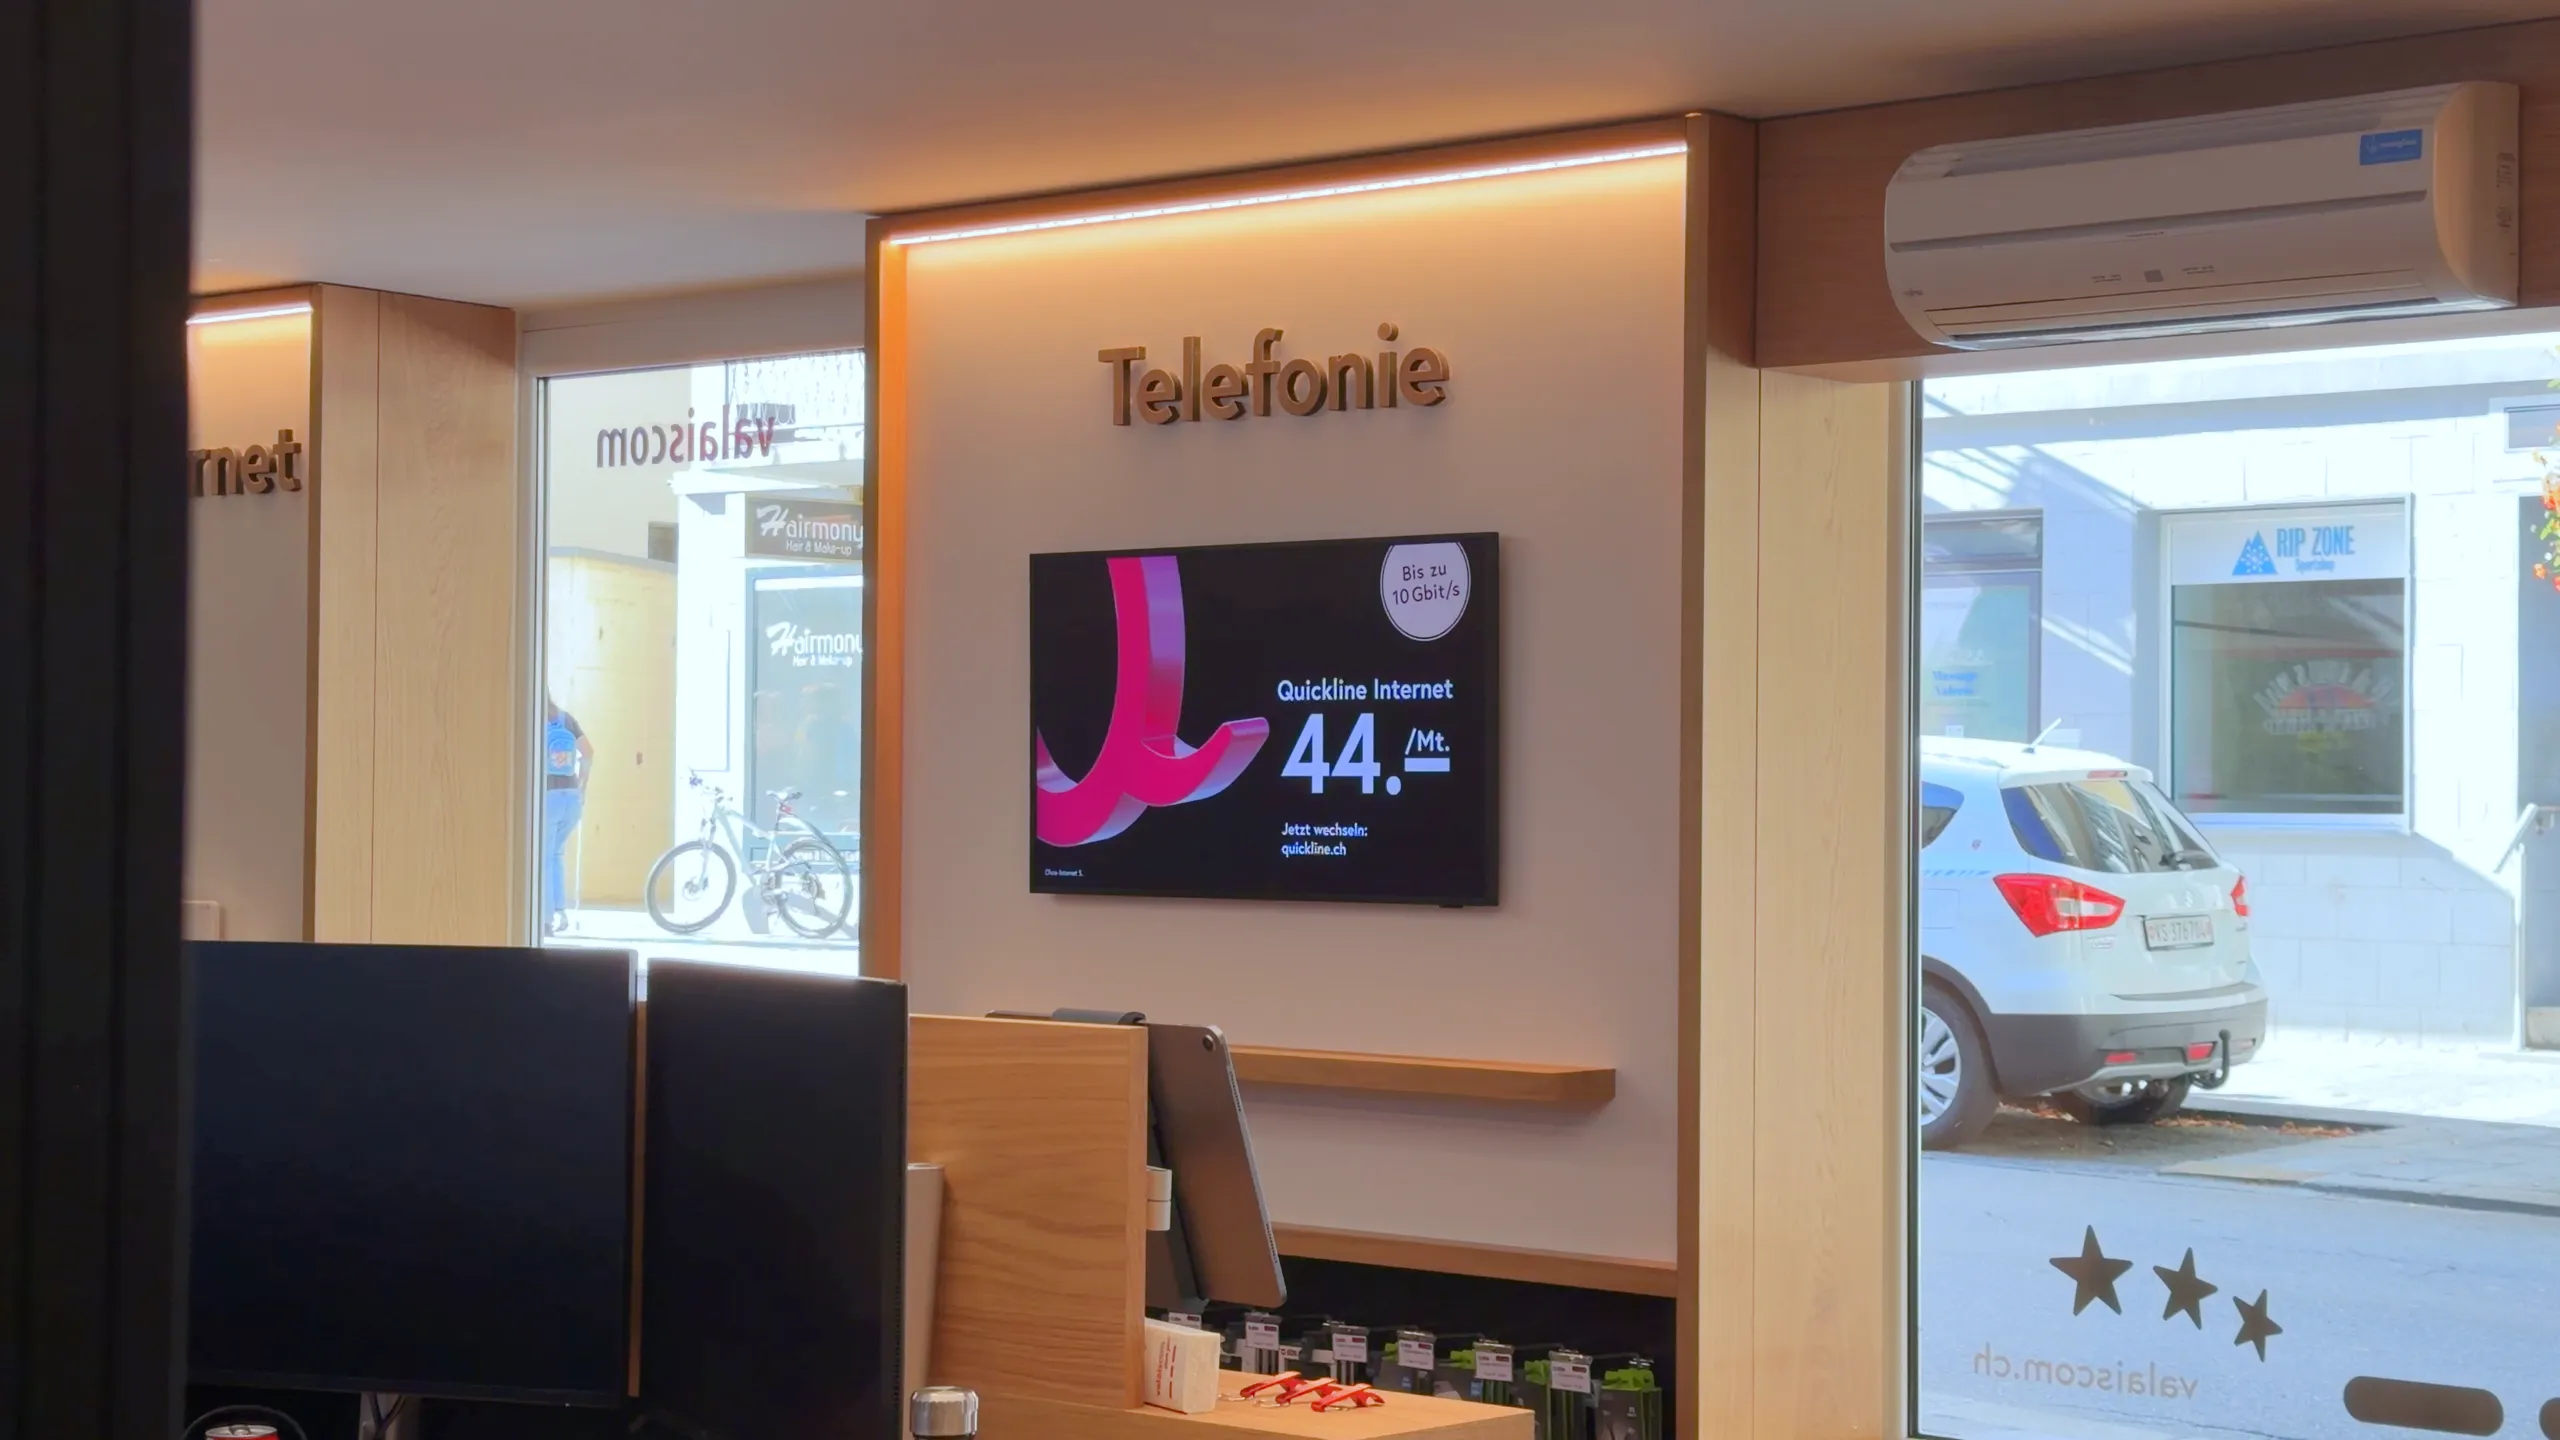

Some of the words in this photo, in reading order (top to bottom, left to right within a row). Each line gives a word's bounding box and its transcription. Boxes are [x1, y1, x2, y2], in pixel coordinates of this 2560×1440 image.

[1098, 322, 1449, 426] Telefonie
[756, 504, 863, 549] Hairmony
[786, 540, 804, 552] Hair
[2276, 528, 2306, 557] RIP
[2312, 526, 2355, 556] ZONE
[1402, 564, 1424, 581] Bis
[1430, 564, 1447, 577] zu
[1392, 588, 1409, 605] 10
[1412, 579, 1460, 602] Gbit/s
[1277, 677, 1367, 701] Quickline
[1374, 678, 1454, 700] Internet
[1404, 727, 1450, 755] /Mt.
[1281, 822, 1311, 836] Jetzt
[1313, 822, 1368, 837] wechseln:
[1281, 841, 1347, 858] quickline.ch
